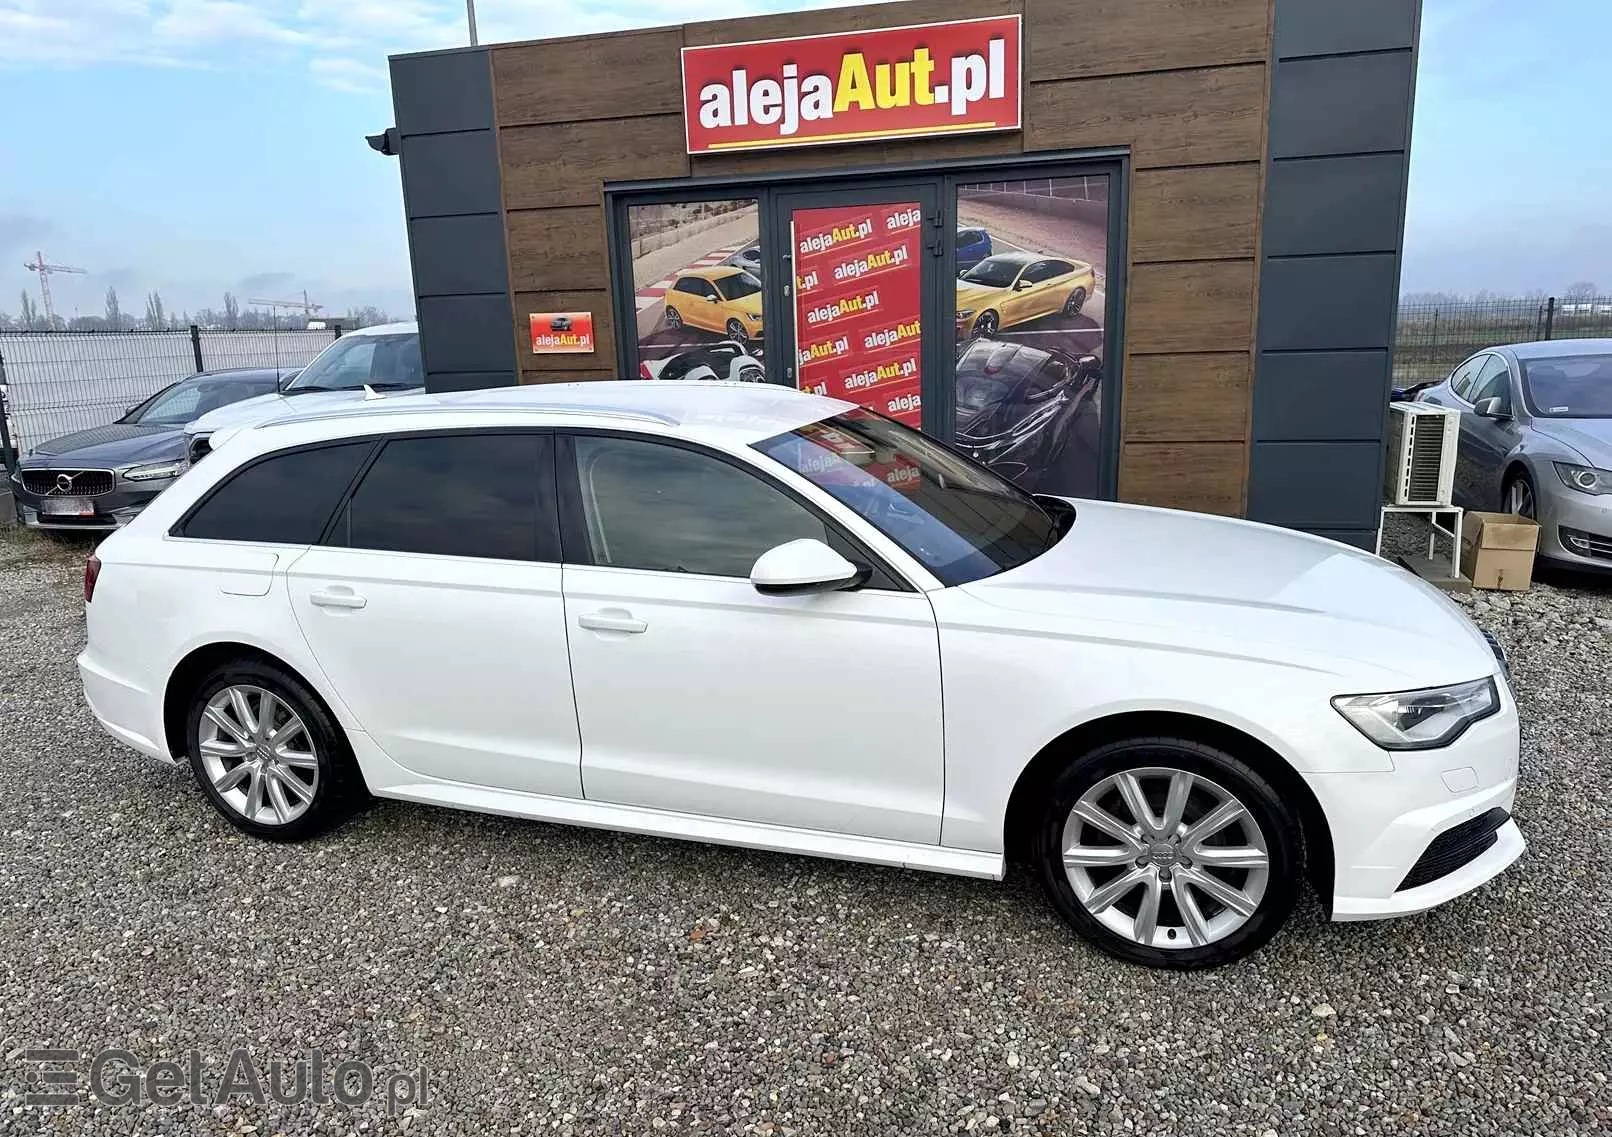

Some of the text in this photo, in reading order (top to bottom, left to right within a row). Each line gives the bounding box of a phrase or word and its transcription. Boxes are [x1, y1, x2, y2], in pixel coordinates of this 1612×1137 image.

[699, 39, 1005, 136] alejaAut.pl
[886, 208, 921, 229] aleja
[799, 218, 873, 253] alejaAut.pl
[834, 245, 909, 279] alejaAut.pl
[807, 290, 880, 323] alejaAut.pl
[535, 333, 590, 347] alejaAut.pl
[844, 358, 917, 389] alejaAut.pl
[887, 394, 921, 412] aleja
